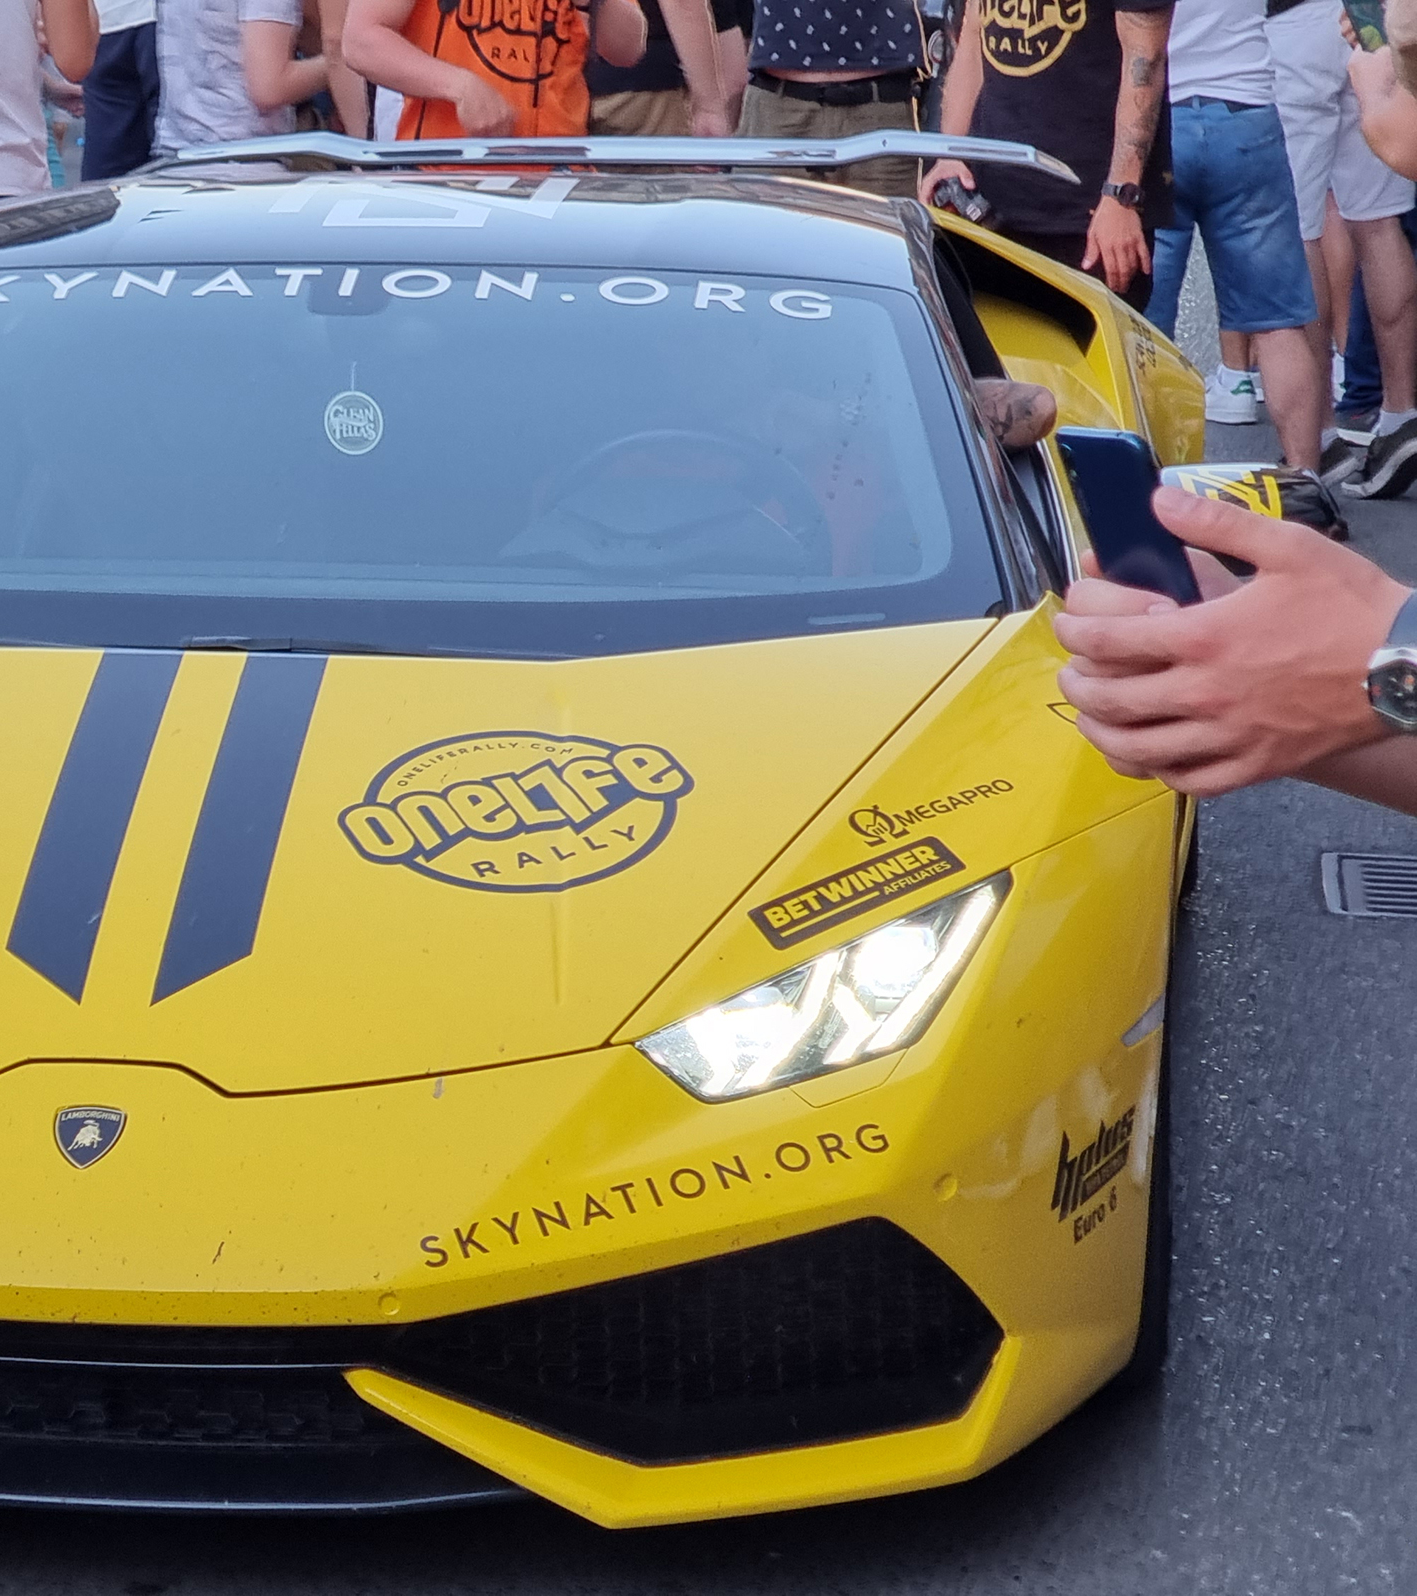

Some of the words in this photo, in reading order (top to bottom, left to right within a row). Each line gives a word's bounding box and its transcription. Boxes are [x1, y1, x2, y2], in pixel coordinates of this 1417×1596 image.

[490, 46, 531, 64] RAL
[988, 36, 1049, 56] RALLY
[396, 741, 574, 788] ONELIFERALLY.COM
[470, 824, 636, 879] RALLY
[762, 844, 941, 930] BETWINNER
[882, 860, 952, 896] AFFILIATES
[61, 1110, 121, 1122] LAMBORGHINI
[418, 1122, 891, 1270] SKYNATION.ORG
[1073, 1202, 1107, 1246] Euro
